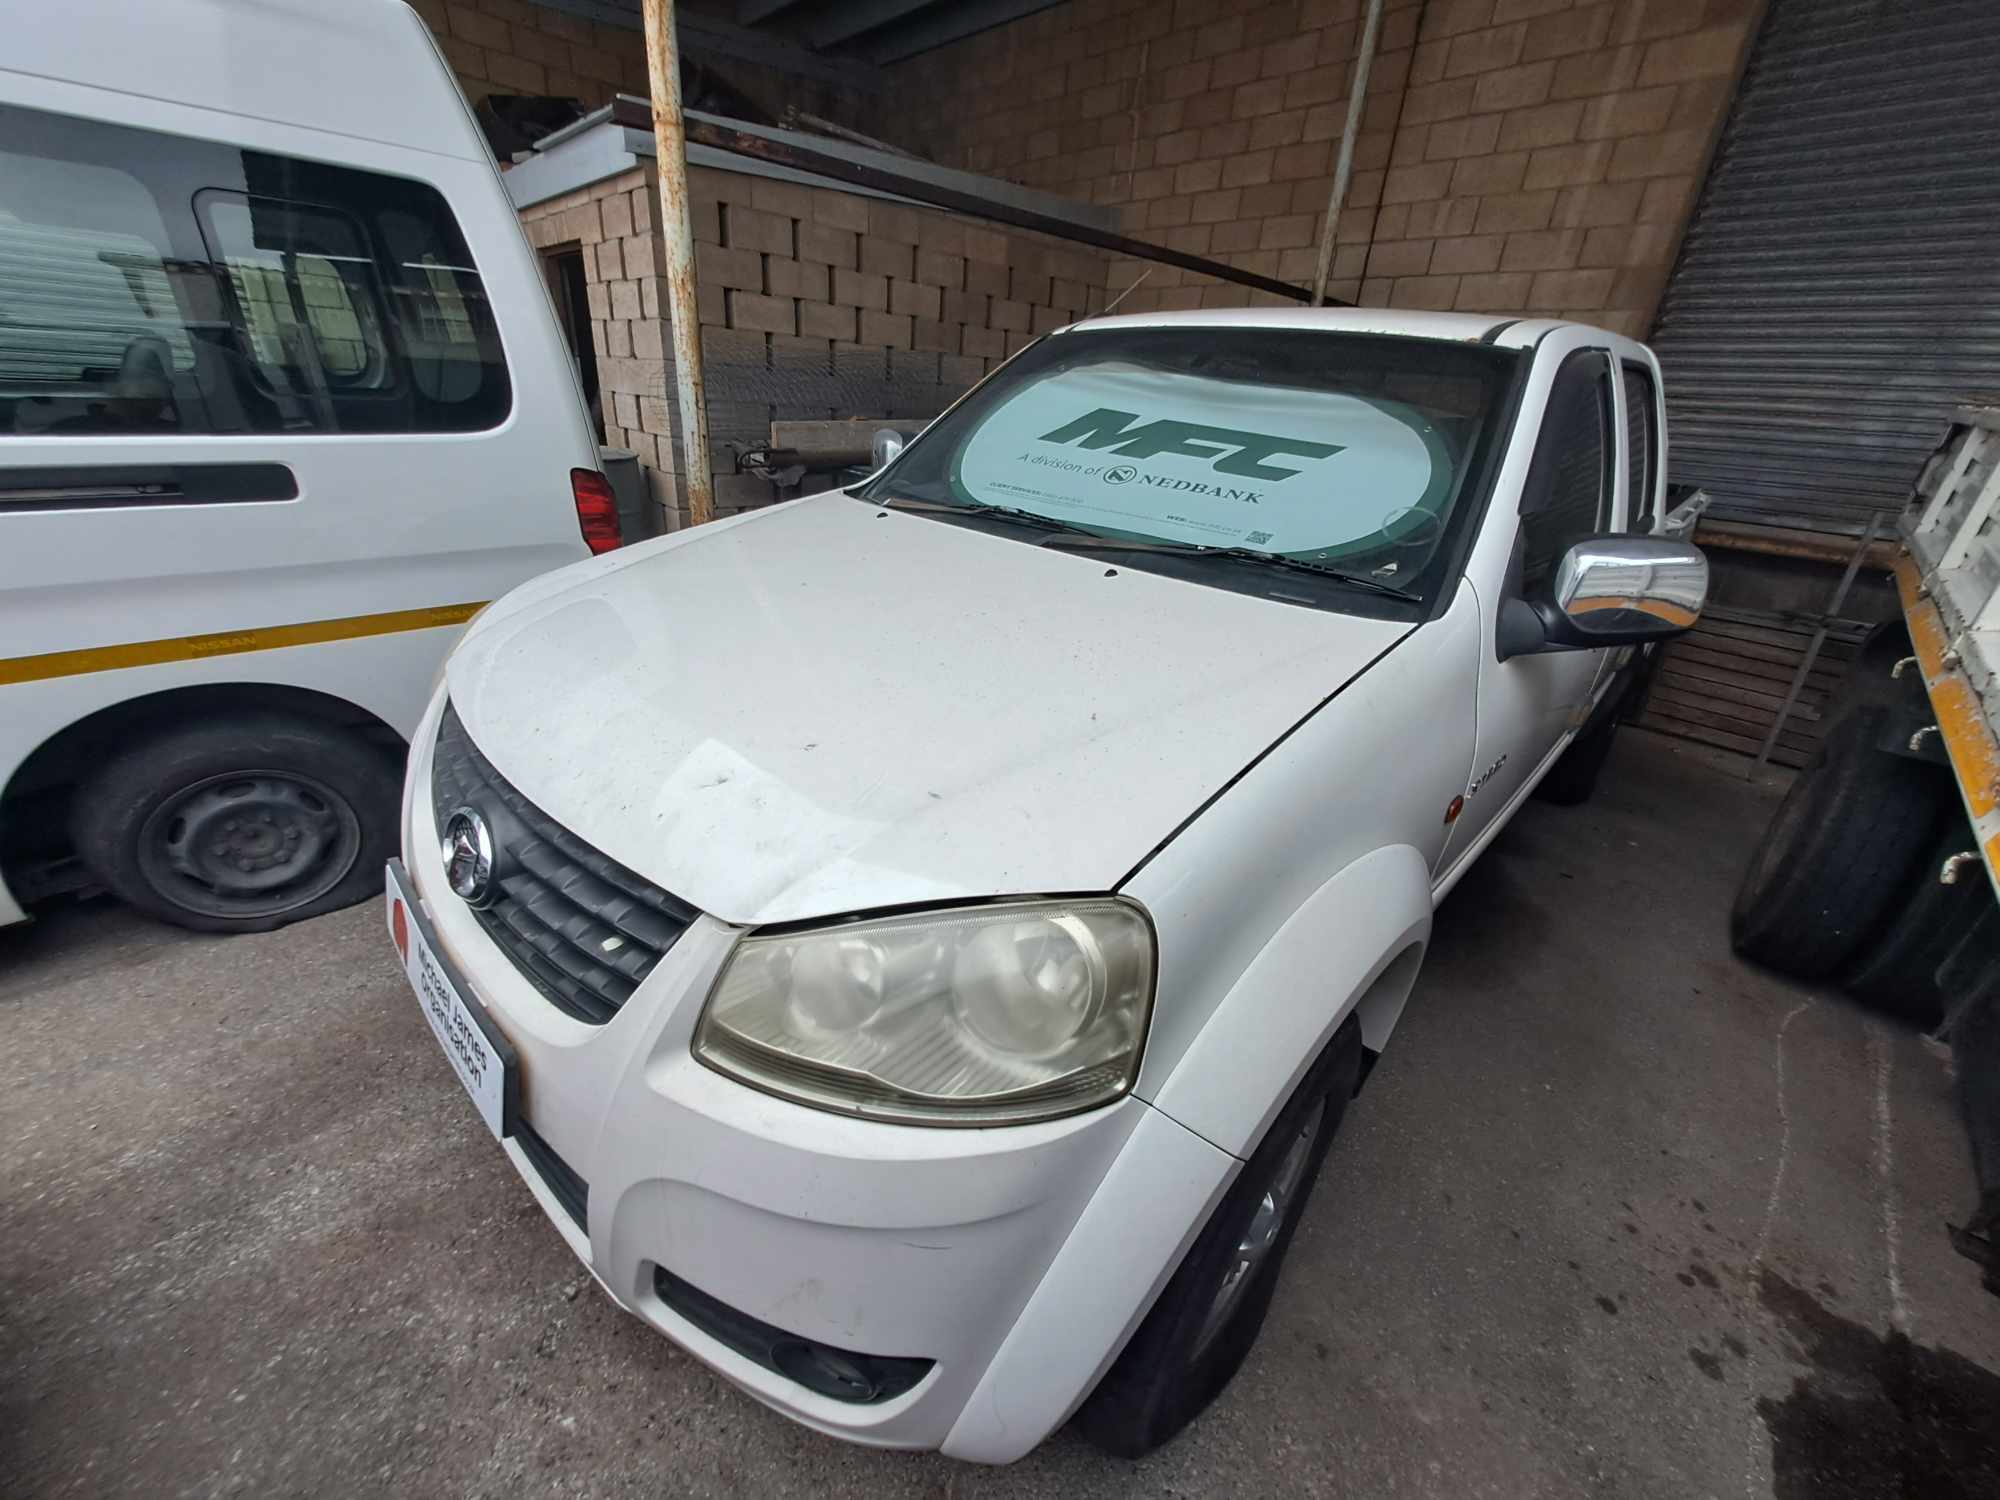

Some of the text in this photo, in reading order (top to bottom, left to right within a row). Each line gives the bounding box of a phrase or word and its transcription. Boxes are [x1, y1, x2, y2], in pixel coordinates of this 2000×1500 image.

[1037, 407, 1347, 482] MFC
[1016, 453, 1265, 505] A division of NEDBANK
[185, 635, 257, 652] NISSAN
[418, 942, 487, 1071] Michael James
